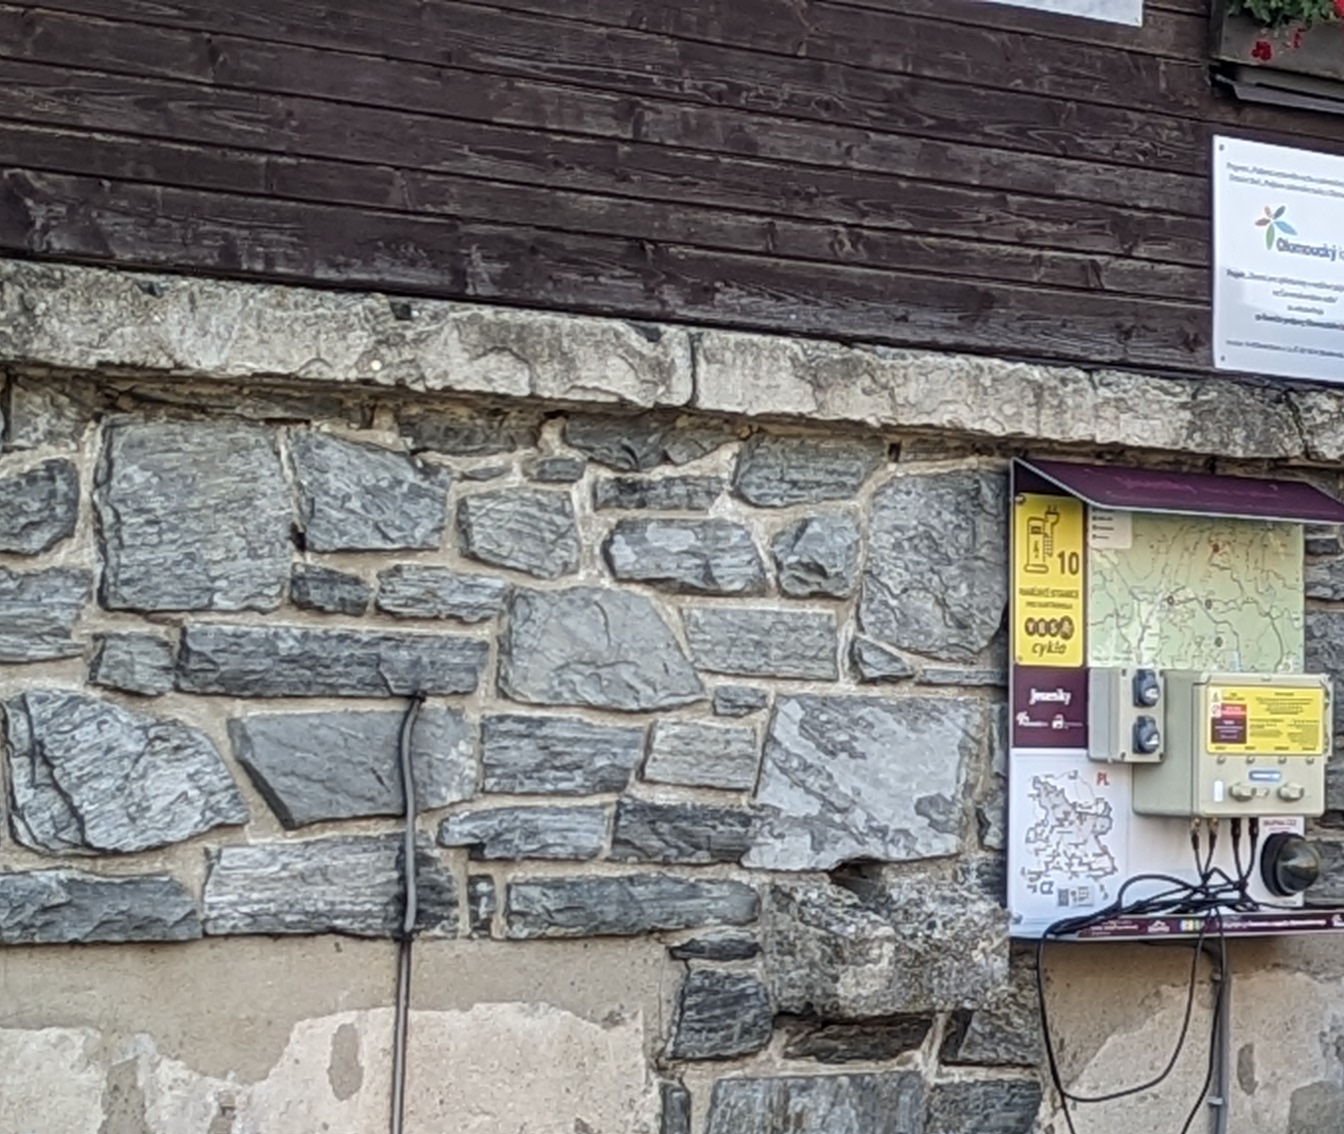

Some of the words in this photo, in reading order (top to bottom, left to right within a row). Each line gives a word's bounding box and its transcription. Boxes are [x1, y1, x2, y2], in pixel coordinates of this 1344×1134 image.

[1057, 550, 1080, 575] 10
[1032, 640, 1067, 658] cyklo
[1096, 771, 1110, 786] PL
